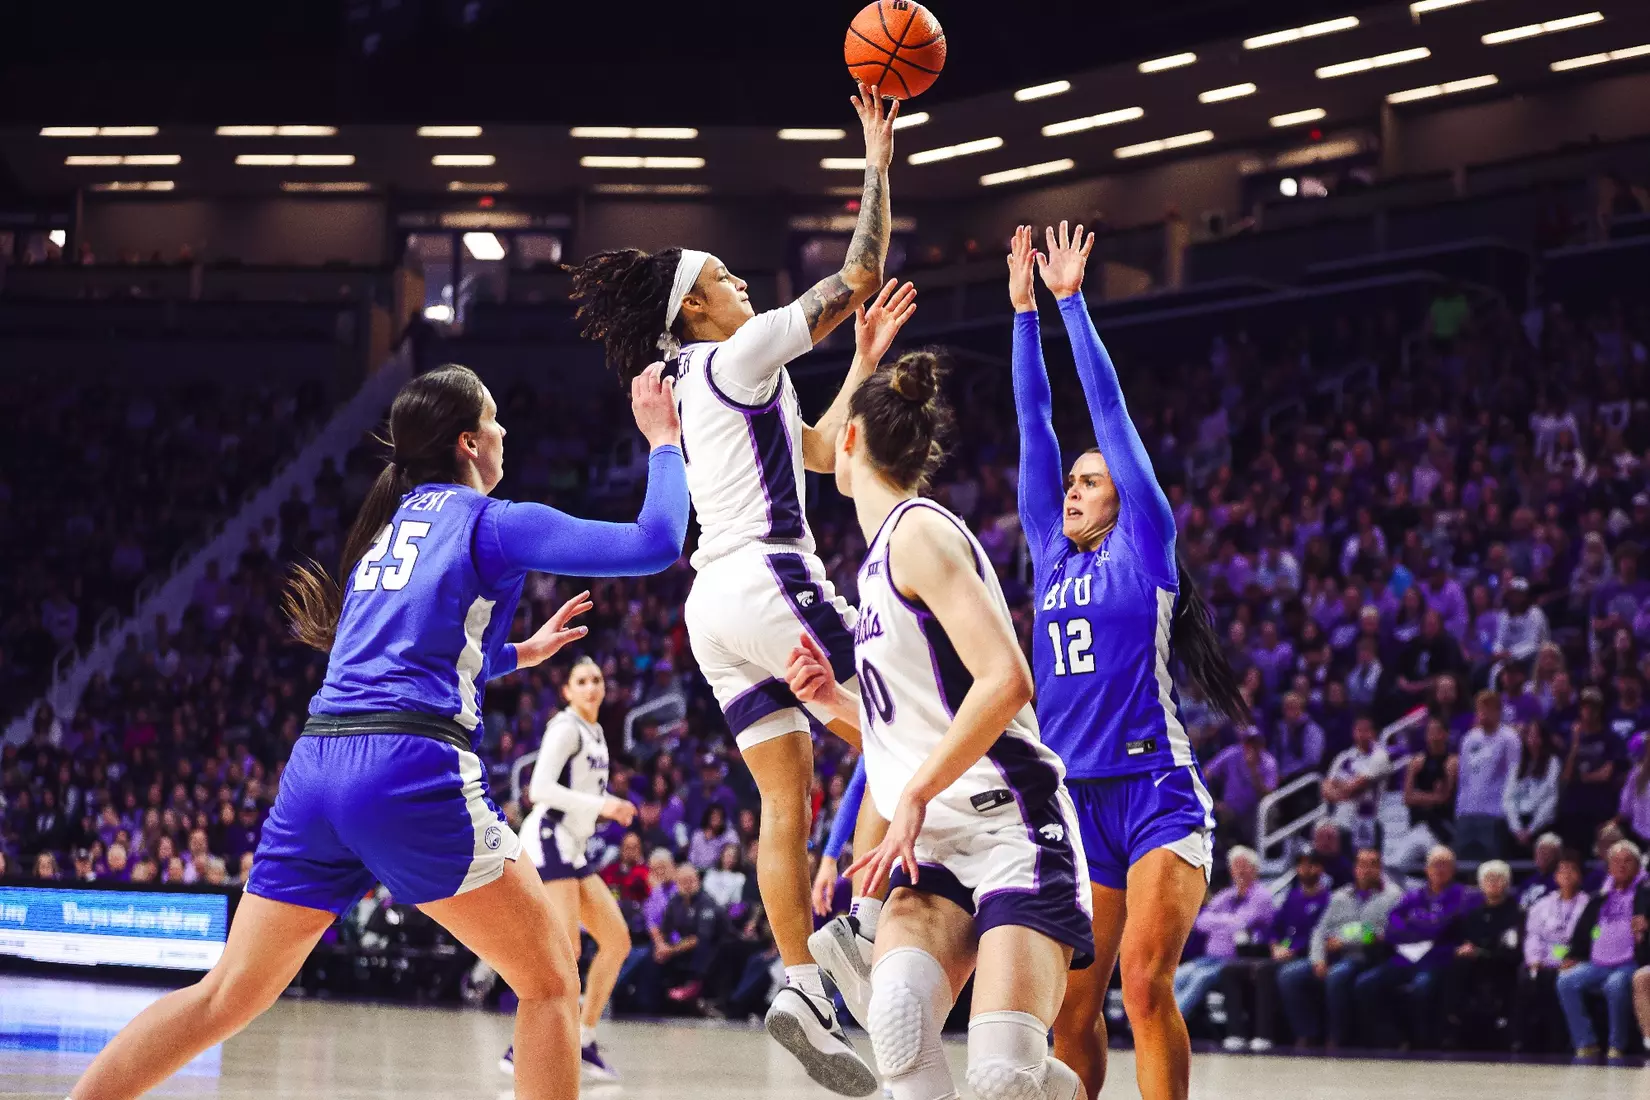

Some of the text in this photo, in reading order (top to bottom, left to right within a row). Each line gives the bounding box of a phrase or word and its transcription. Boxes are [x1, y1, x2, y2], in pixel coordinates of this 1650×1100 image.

[353, 520, 432, 593] 25
[1043, 573, 1093, 611] BYU
[1048, 618, 1096, 676] 12
